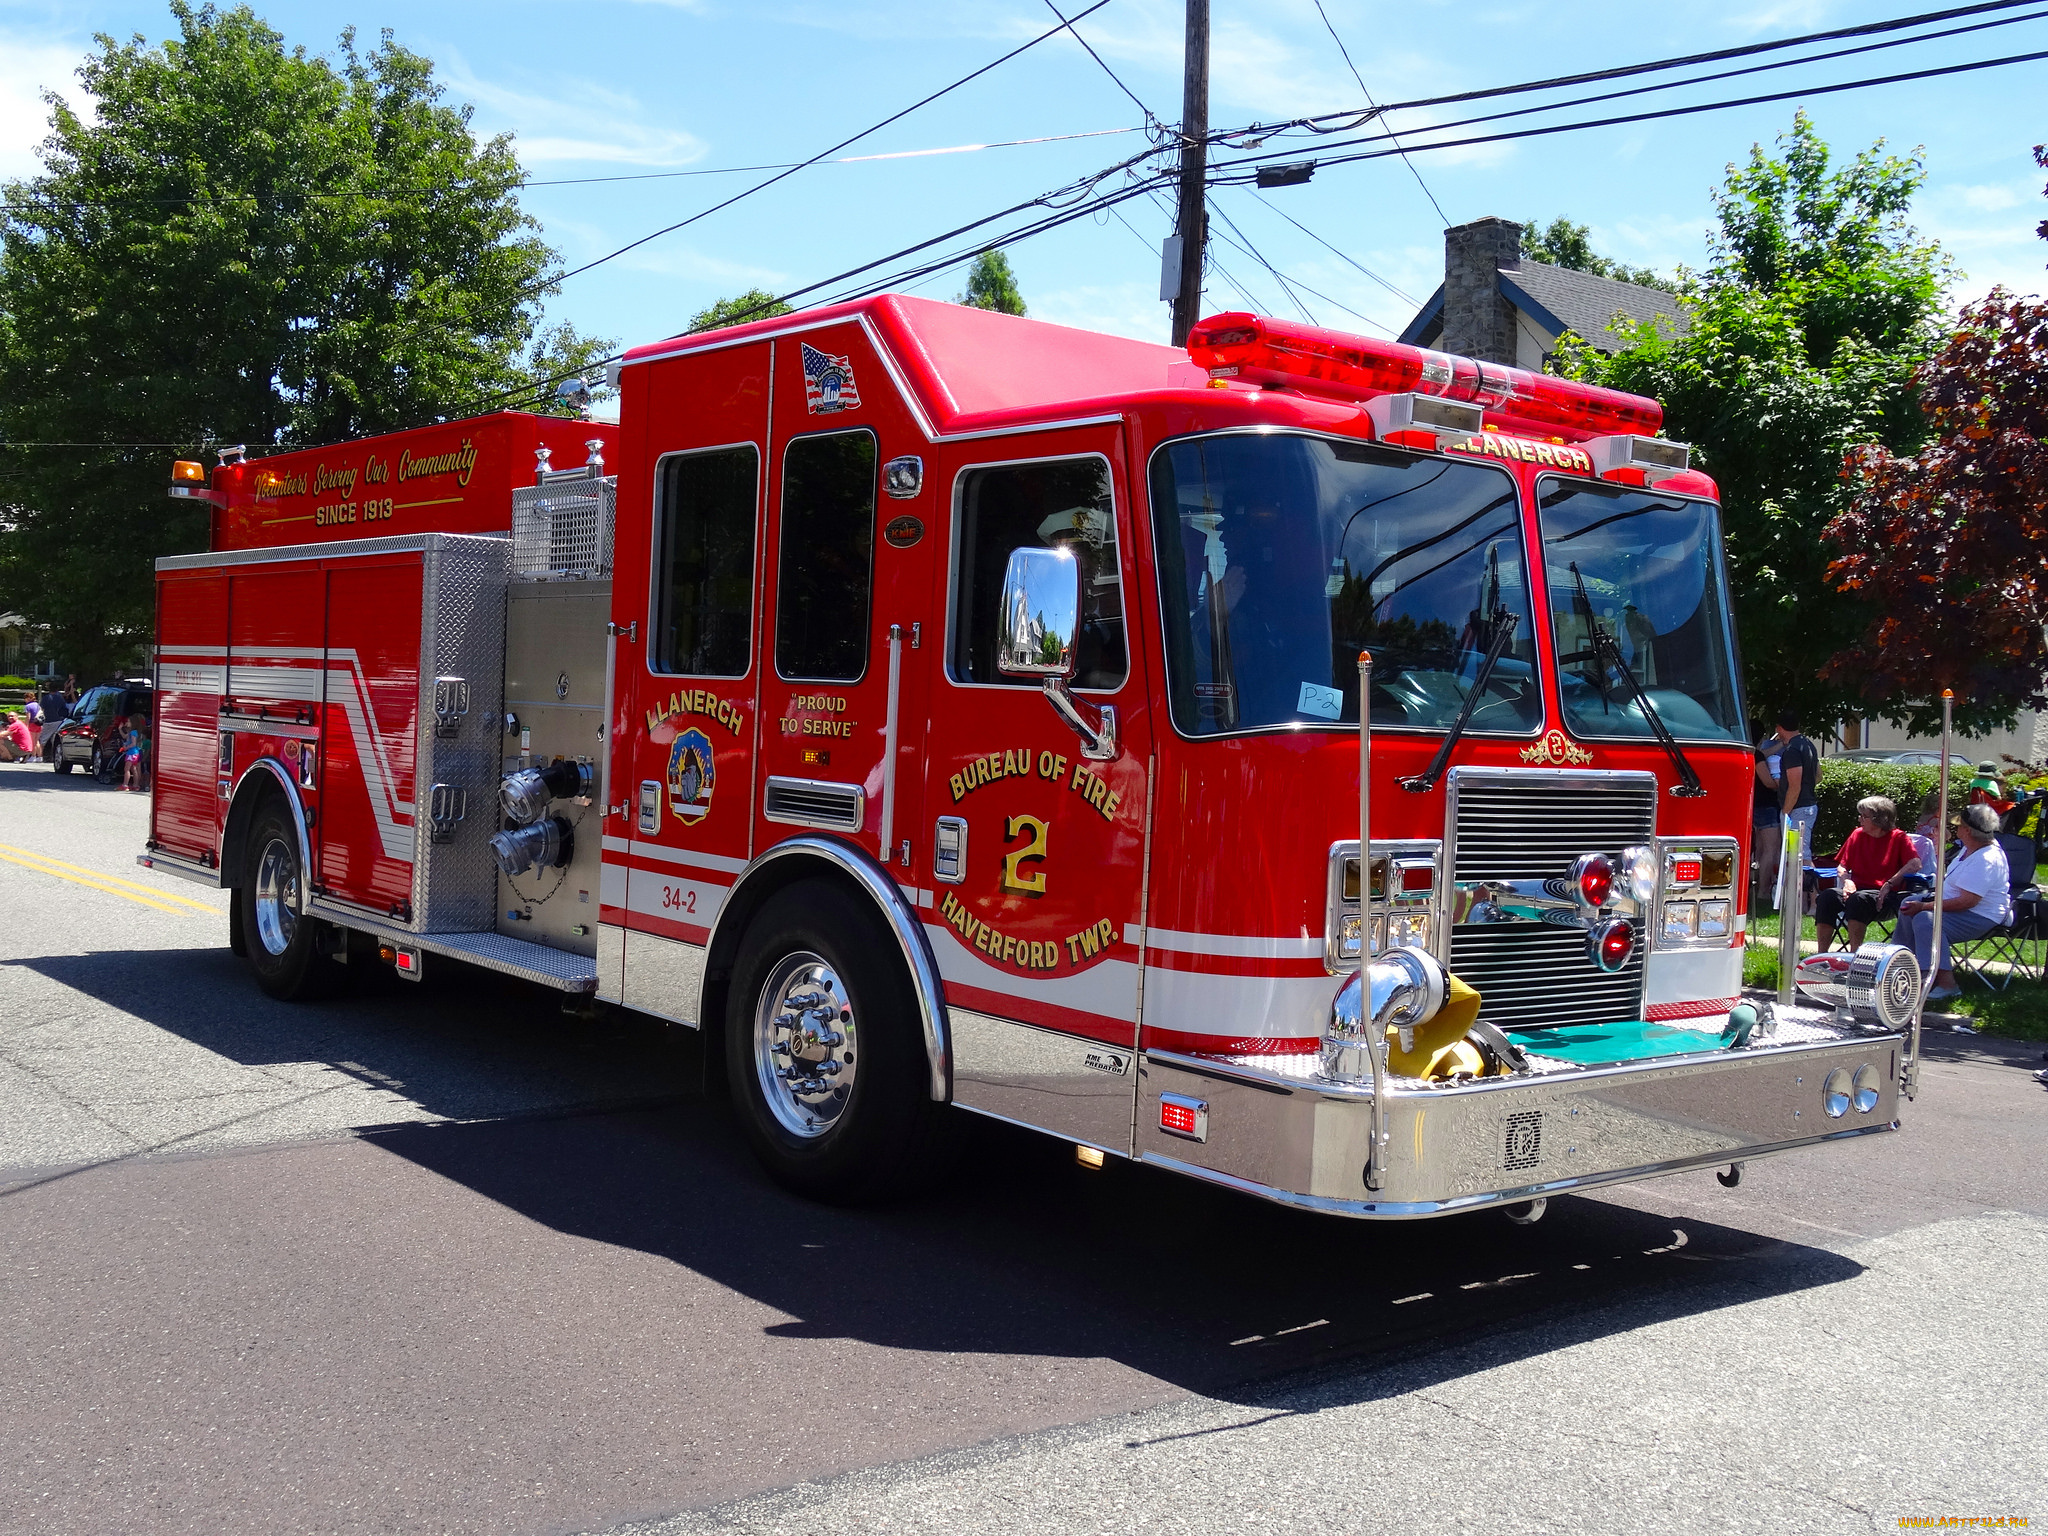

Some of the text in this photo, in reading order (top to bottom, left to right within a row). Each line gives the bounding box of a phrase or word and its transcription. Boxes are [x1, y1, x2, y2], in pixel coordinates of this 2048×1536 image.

[254, 438, 478, 504] Volunteers Serving Our Community
[316, 498, 393, 526] SINCE 1913
[645, 689, 744, 736] LLANERCH
[1303, 686, 1339, 711] P-2
[779, 717, 799, 733] TO
[1550, 735, 1563, 756] 2
[949, 748, 1121, 822] BUREAU OF FIRE
[1004, 814, 1050, 893] 2
[662, 885, 697, 914] 34-2
[941, 890, 1119, 968] HAVERFORD TWP.
[1084, 1060, 1123, 1074] PREDATOR
[1086, 1053, 1102, 1063] KME
